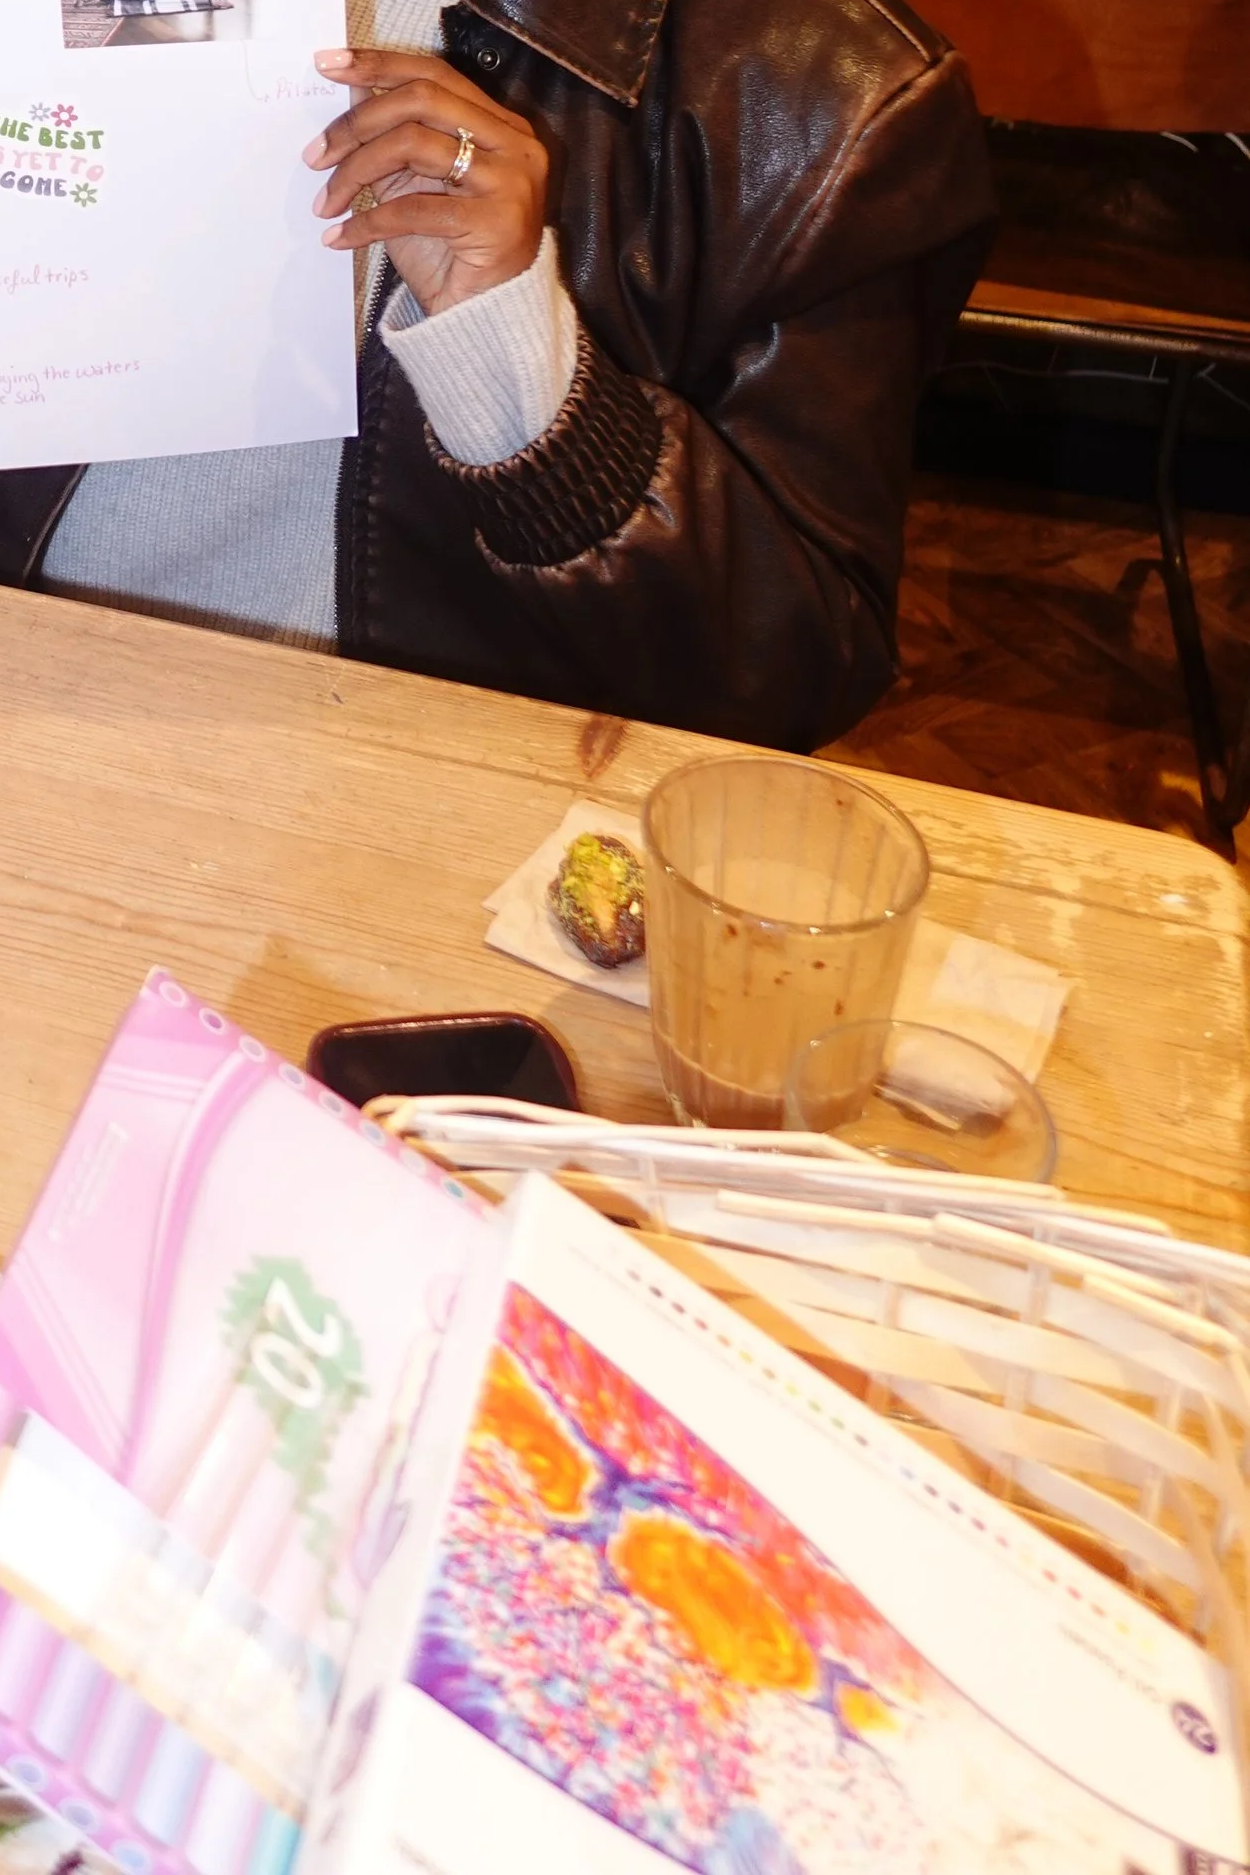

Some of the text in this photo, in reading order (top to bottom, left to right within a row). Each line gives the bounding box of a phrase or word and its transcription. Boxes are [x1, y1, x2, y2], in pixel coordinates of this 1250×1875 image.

[276, 76, 337, 100] Pilates
[38, 126, 105, 150] BEST
[12, 149, 62, 171] YET
[70, 155, 105, 182] TO
[44, 267, 89, 288] trips
[42, 365, 71, 380] the
[75, 359, 141, 380] waters
[248, 1275, 344, 1410] 20
